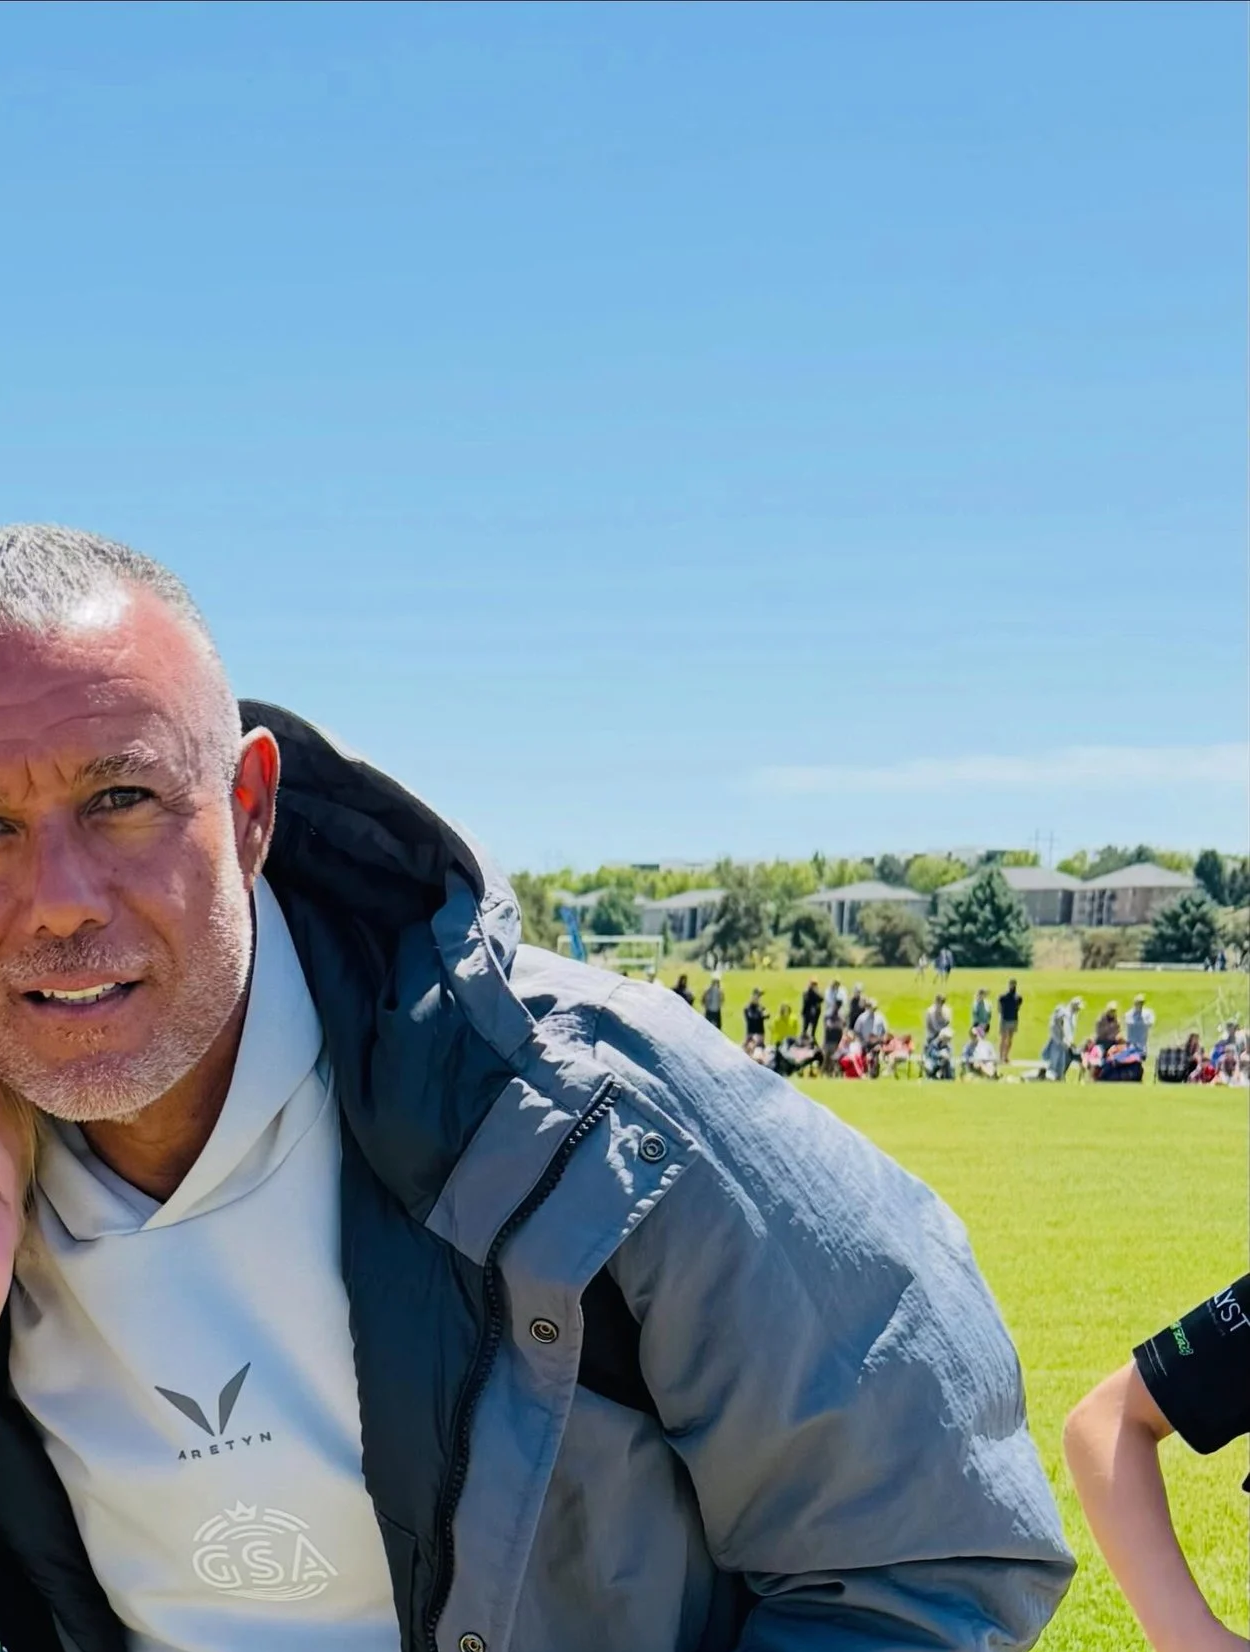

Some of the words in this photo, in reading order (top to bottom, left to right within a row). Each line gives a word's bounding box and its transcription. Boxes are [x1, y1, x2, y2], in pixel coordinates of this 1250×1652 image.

[1214, 1287, 1250, 1332] LYST
[177, 1431, 272, 1460] ARETYN
[192, 1532, 338, 1589] GSA
